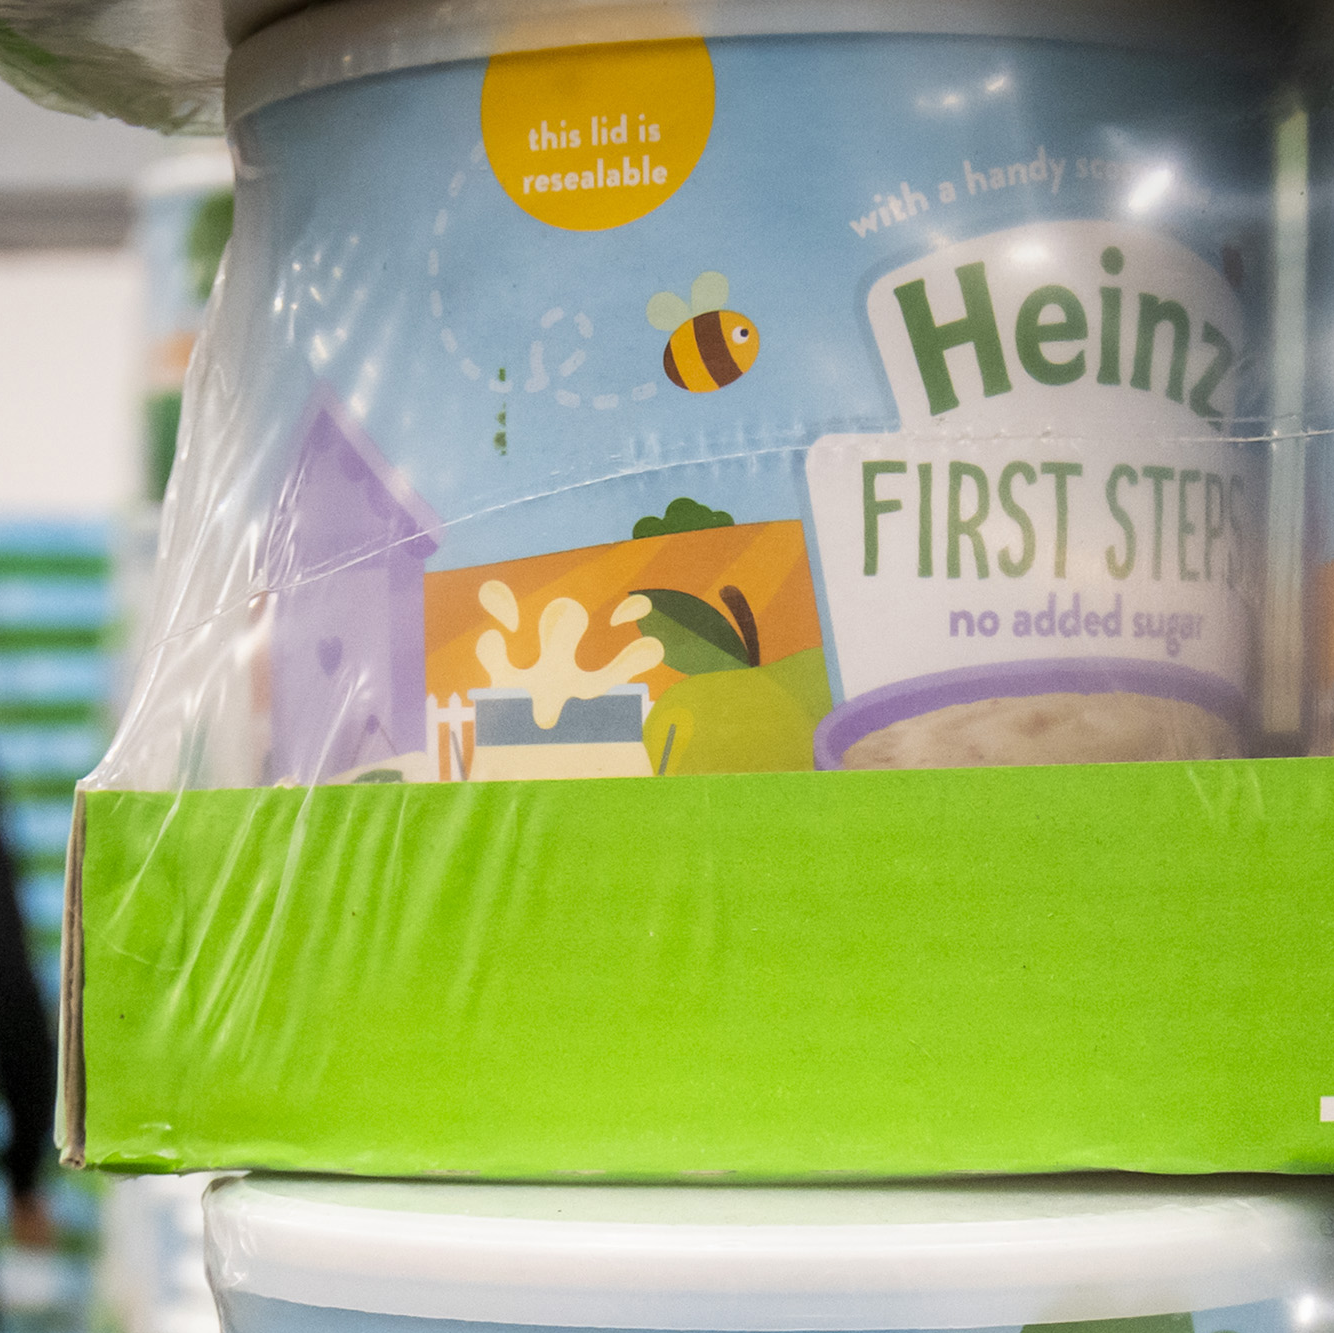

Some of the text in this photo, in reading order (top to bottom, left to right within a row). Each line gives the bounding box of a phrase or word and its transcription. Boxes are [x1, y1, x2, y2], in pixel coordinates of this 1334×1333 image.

[528, 114, 661, 152] this lid is
[522, 155, 668, 194] resealable
[849, 180, 931, 238] with
[938, 179, 957, 204] a
[963, 145, 1065, 196] handy
[893, 246, 1237, 430] Heinz
[862, 460, 1247, 590] FIRST STEPS
[949, 593, 1205, 658] no added sugar
